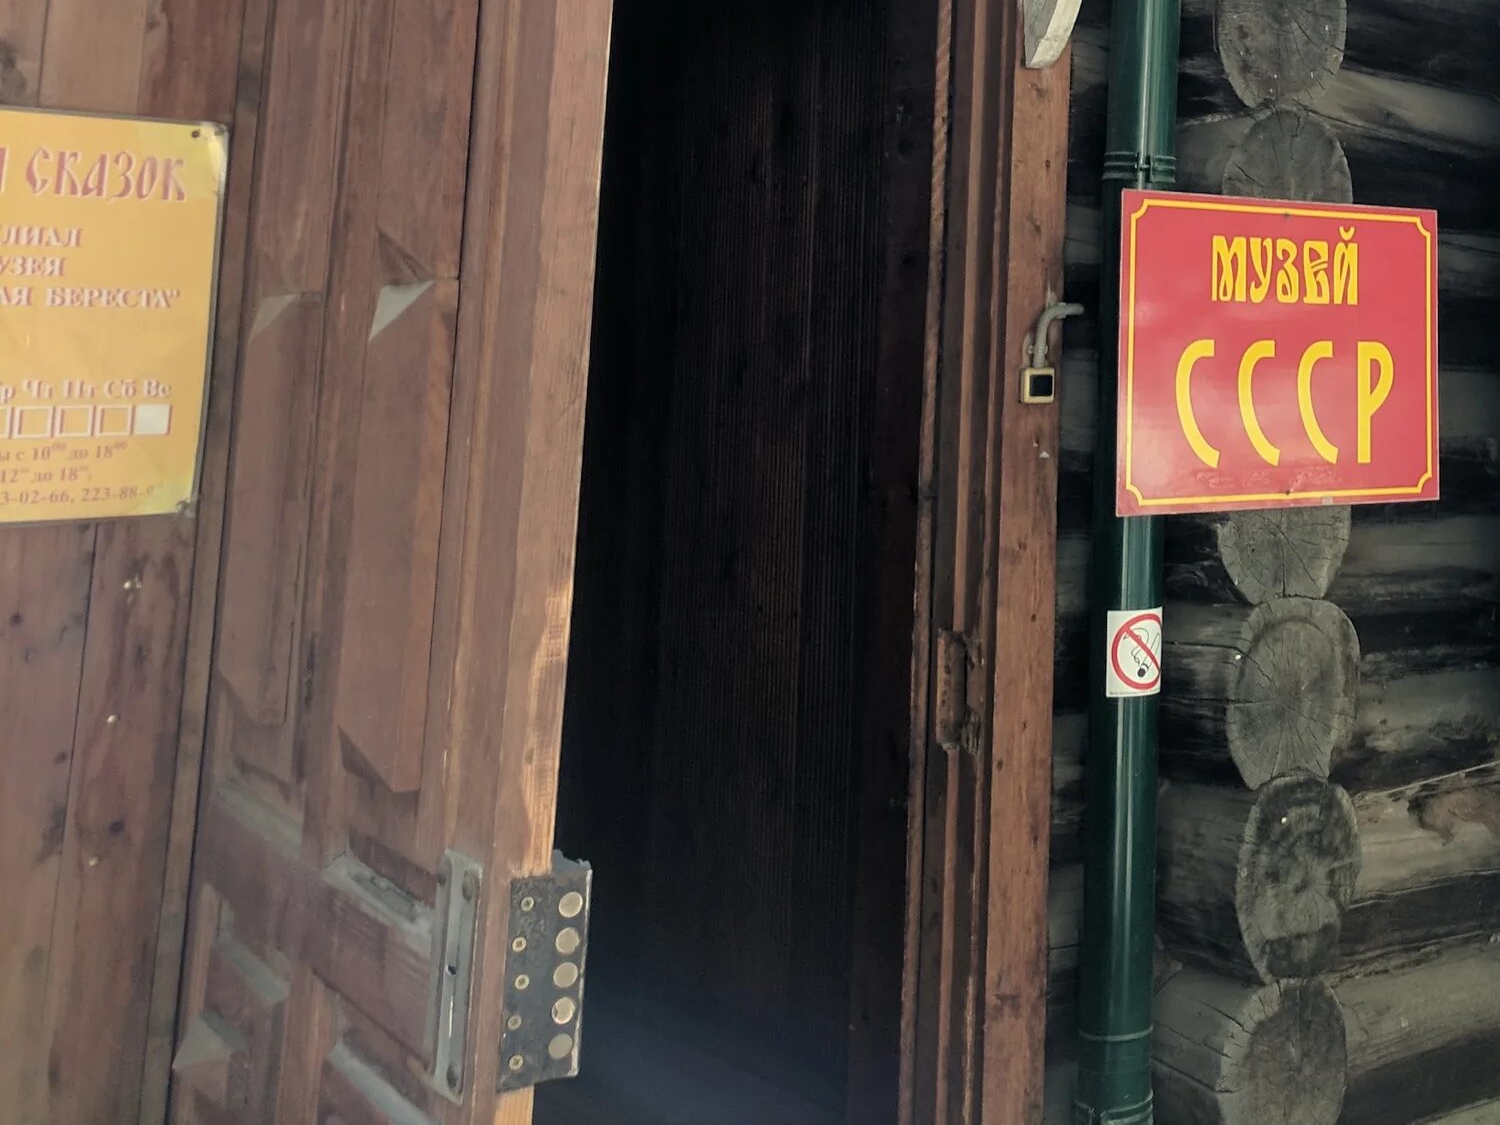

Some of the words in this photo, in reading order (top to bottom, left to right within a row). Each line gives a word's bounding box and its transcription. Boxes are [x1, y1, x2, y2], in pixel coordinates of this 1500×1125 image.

[0, 225, 83, 248] ЛИАЛ
[1211, 226, 1358, 306] МУЗЕЙ
[1175, 339, 1395, 468] СССР
